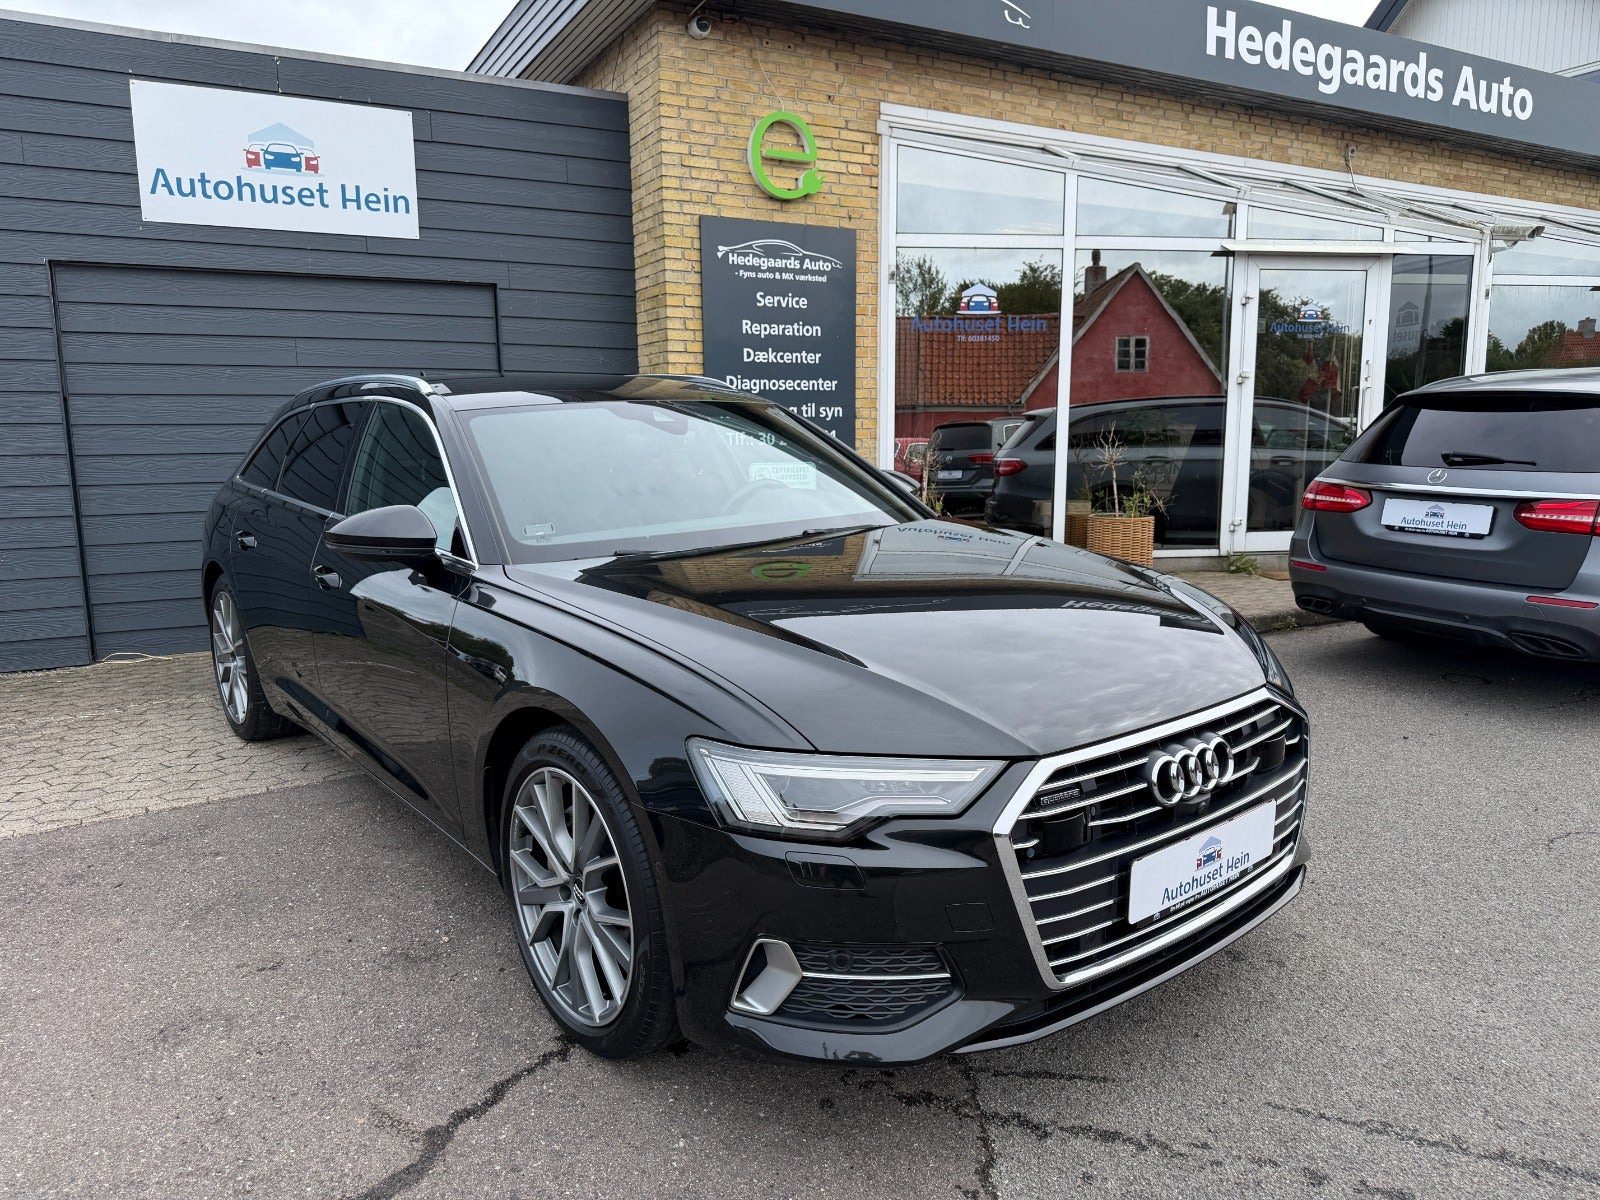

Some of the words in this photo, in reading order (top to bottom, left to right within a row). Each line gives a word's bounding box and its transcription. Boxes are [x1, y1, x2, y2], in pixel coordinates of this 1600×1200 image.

[1206, 6, 1444, 102] Hedegaards
[1452, 66, 1533, 121] Auto
[150, 167, 329, 208] Autohuset
[341, 183, 410, 214] Hein
[728, 253, 800, 270] Hedegaards
[803, 258, 832, 272] Auto
[739, 270, 756, 279] Fyns
[757, 272, 774, 280] auto
[775, 272, 781, 280] &
[782, 272, 795, 281] MX
[795, 273, 827, 283] værksted
[756, 291, 808, 309] Service
[742, 320, 822, 338] Reparation
[910, 315, 1002, 333] Autohuset
[1007, 316, 1047, 333] Hein
[1269, 321, 1324, 334] Autohuset
[1327, 322, 1350, 335] Hein
[743, 347, 822, 364] Dækcenter
[726, 375, 838, 394] Diagnosecenter
[801, 402, 816, 418] til
[819, 406, 843, 421] syn
[1401, 516, 1444, 529] Autohuset
[1446, 520, 1467, 530] Hein
[1161, 863, 1223, 905] Autohuset
[1226, 851, 1250, 874] Hein
